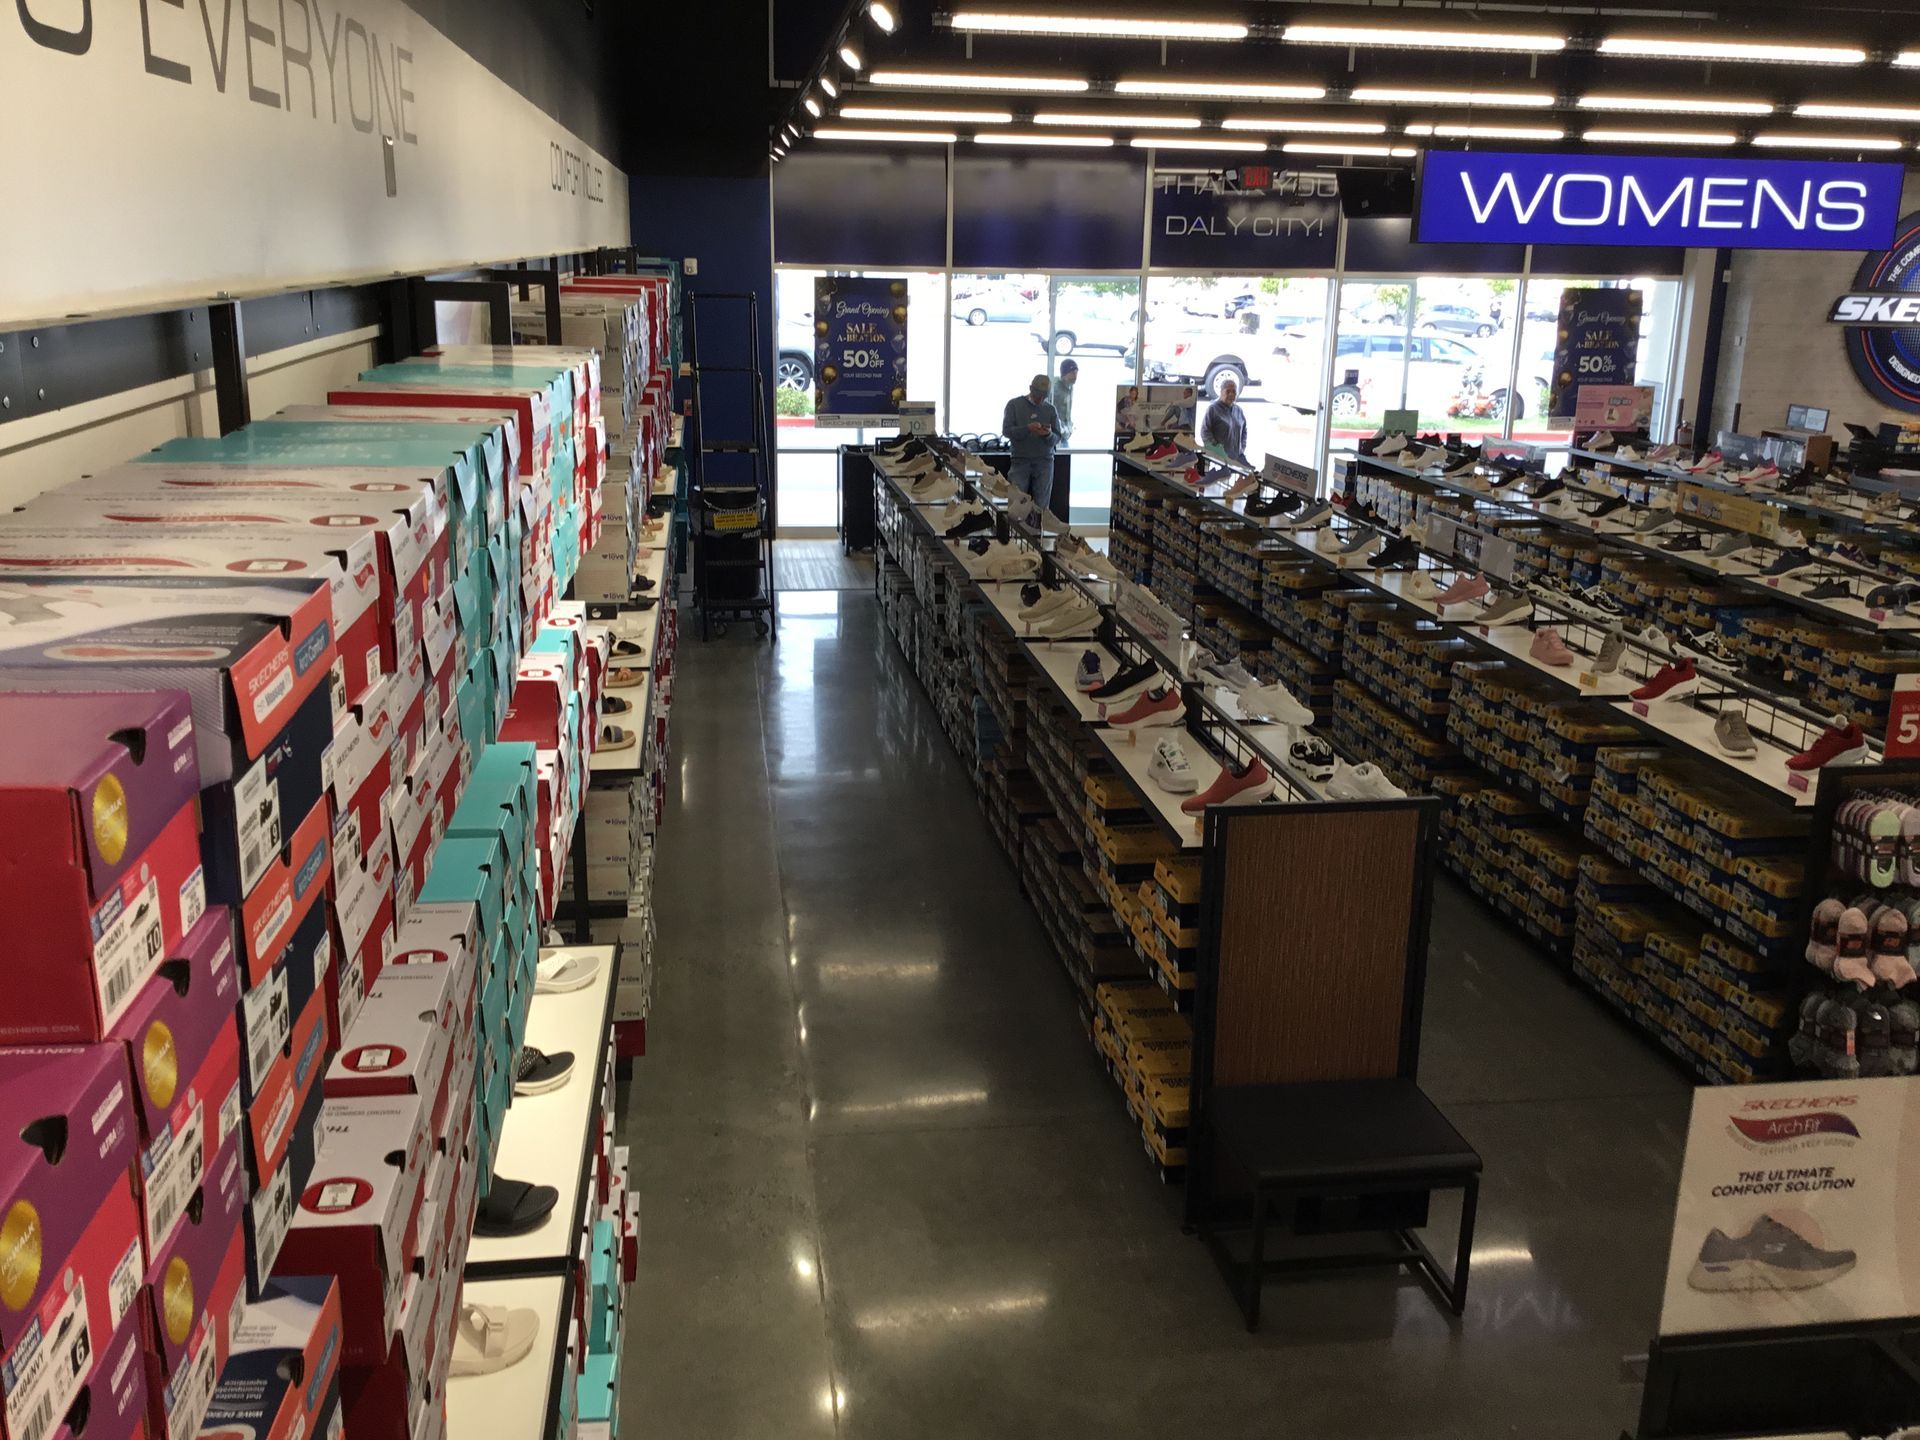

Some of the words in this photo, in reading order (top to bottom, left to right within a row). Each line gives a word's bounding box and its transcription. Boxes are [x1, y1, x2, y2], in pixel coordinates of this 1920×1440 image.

[1244, 167, 1268, 188] EXIT
[1459, 170, 1868, 232] WOMENS
[1165, 216, 1248, 237] DALY
[1252, 216, 1324, 238] CITY!
[835, 300, 861, 319] Grand
[861, 302, 890, 318] Opening
[846, 322, 877, 334] SALE
[869, 359, 885, 368] OFF
[1602, 364, 1616, 373] OFF
[248, 646, 290, 696] SKECHERS
[252, 882, 290, 937] SKECHERS
[148, 921, 162, 958] 10
[1739, 1095, 1859, 1113] SKECHERS
[1767, 1119, 1803, 1136] Arch
[1804, 1118, 1821, 1133] Fit
[100, 1128, 117, 1159] ULTRA
[1737, 1171, 1765, 1183] THE
[1767, 1166, 1835, 1182] ULTIMATE
[1711, 1182, 1782, 1198] COMFORT
[1784, 1177, 1856, 1194] SOLUTION
[75, 1338, 85, 1367] 6
